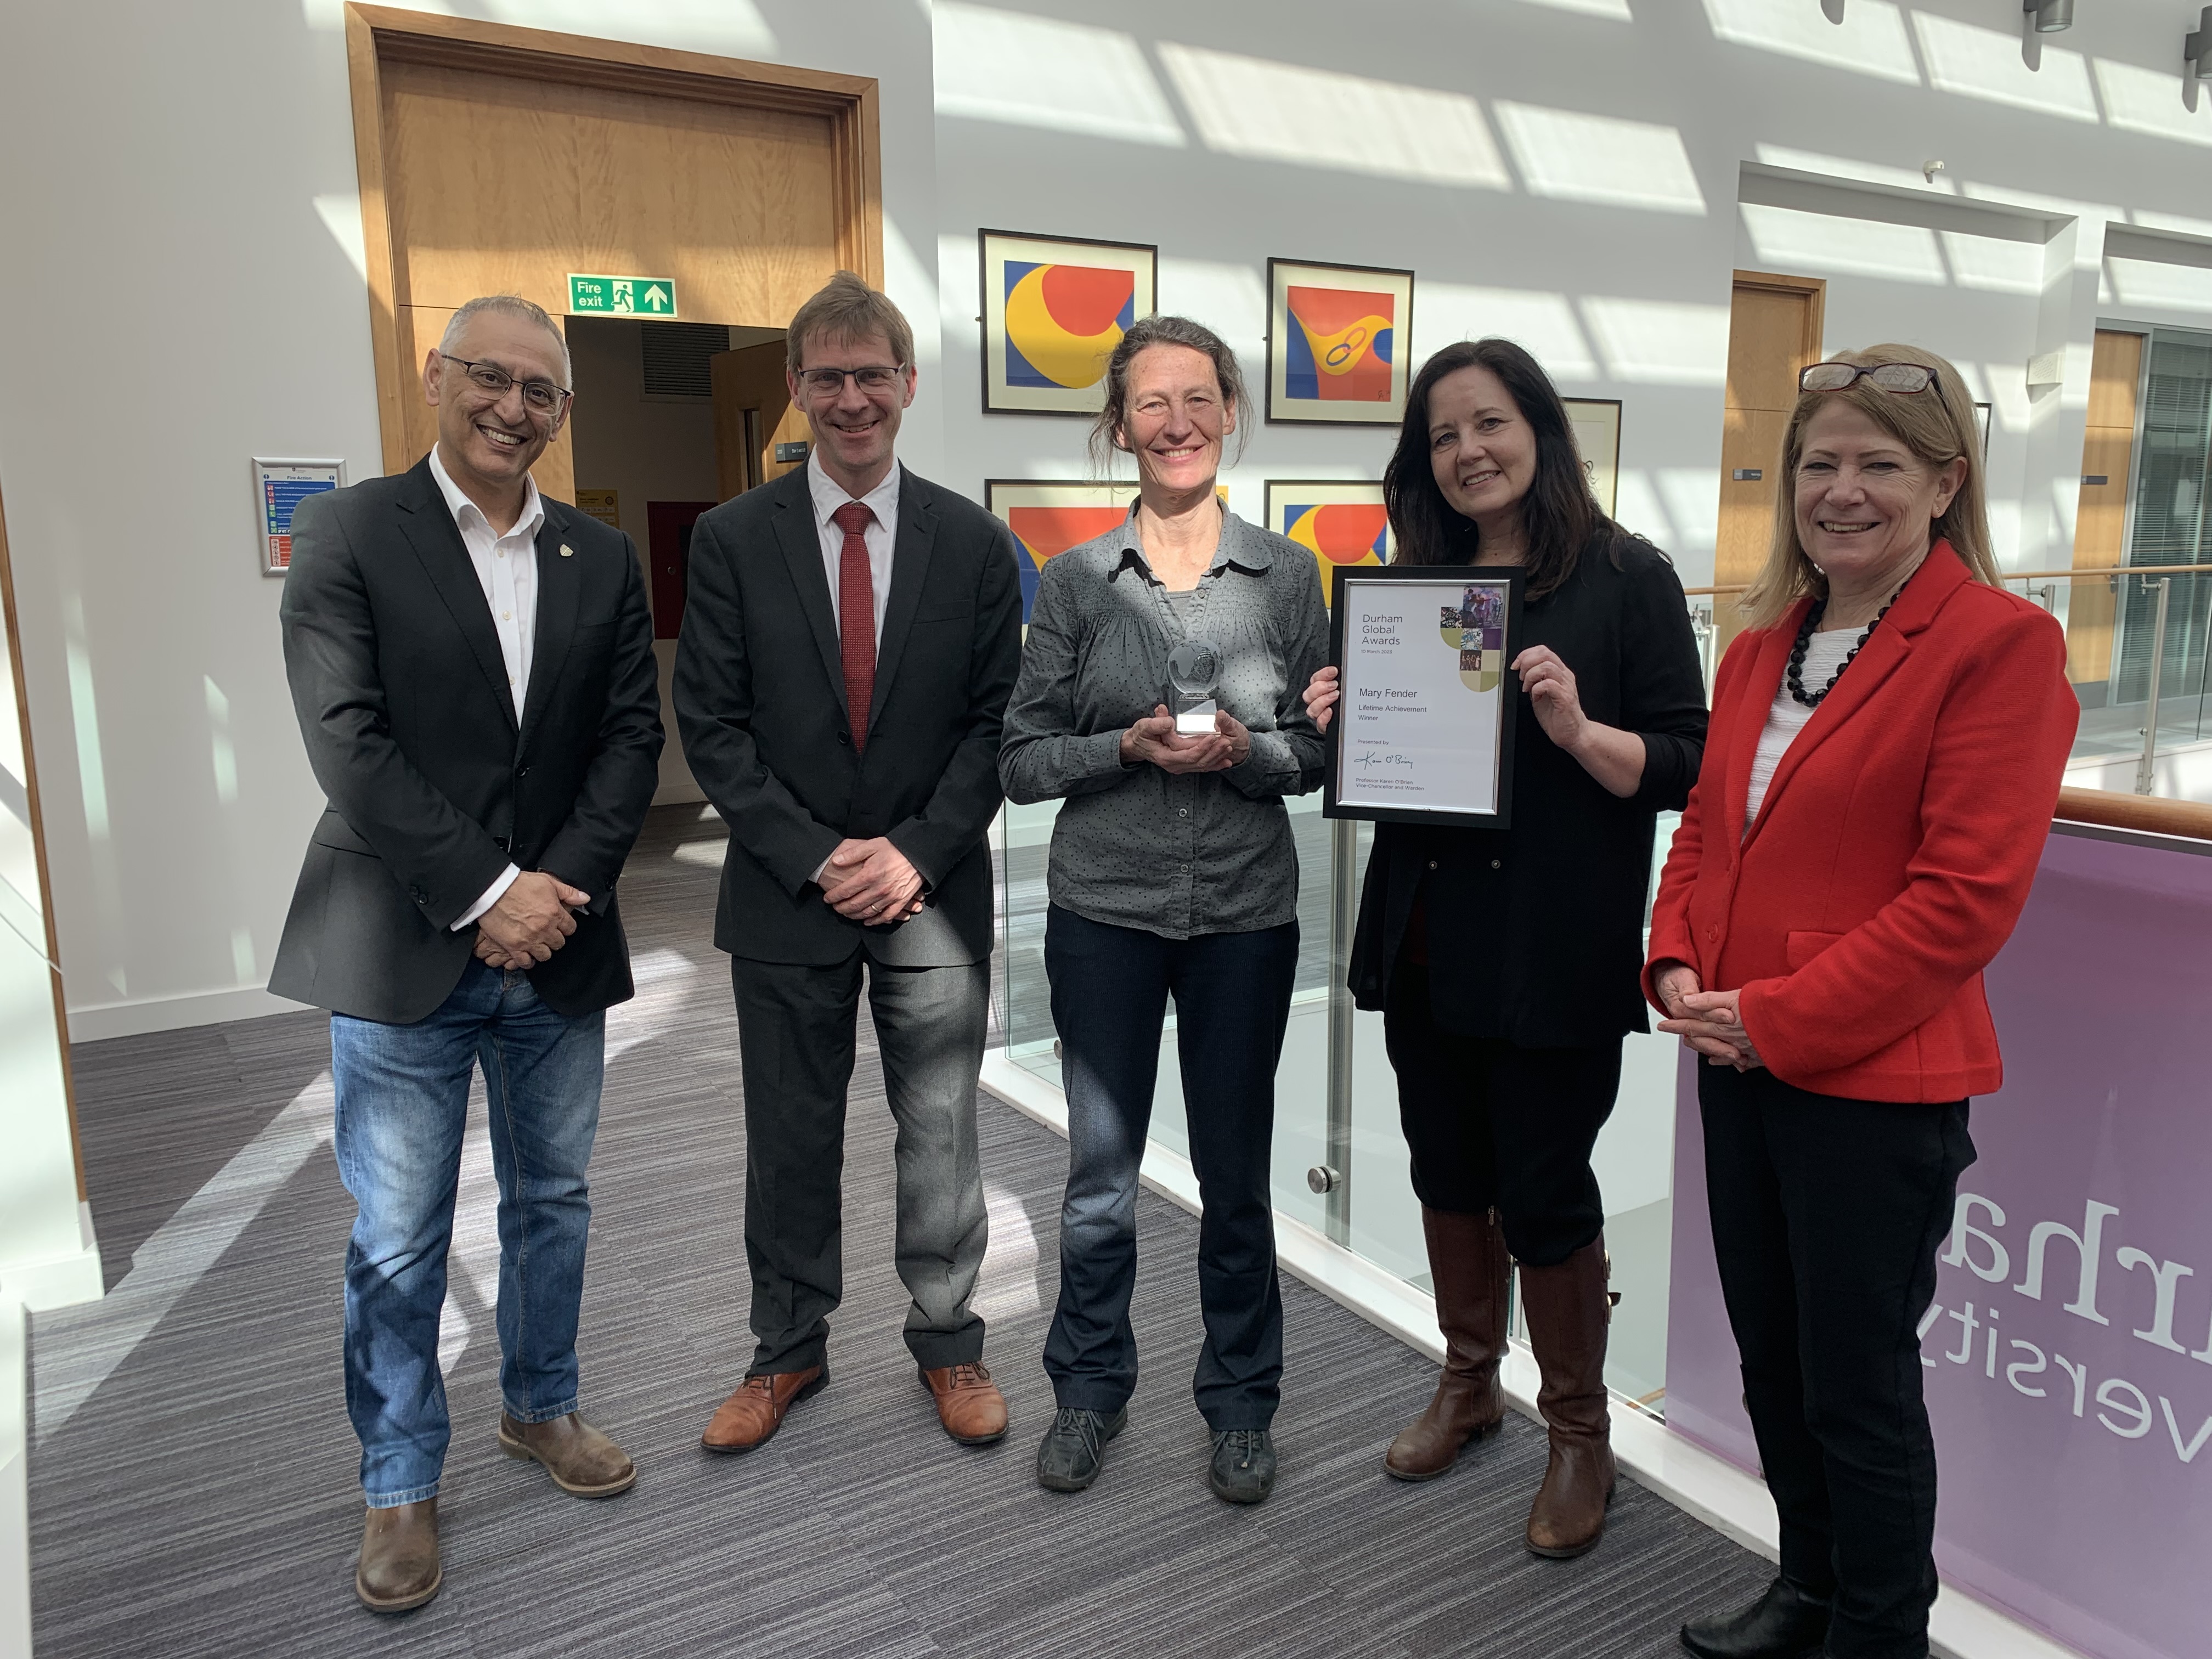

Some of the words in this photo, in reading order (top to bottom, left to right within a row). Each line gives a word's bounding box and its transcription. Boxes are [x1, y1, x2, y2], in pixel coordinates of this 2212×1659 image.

[577, 281, 602, 294] Fire
[579, 295, 603, 307] exit
[1363, 614, 1403, 623] Durham
[1362, 625, 1395, 634] Global
[1362, 636, 1400, 645] Awards
[1359, 688, 1382, 699] Mary
[1385, 689, 1418, 698] Fender
